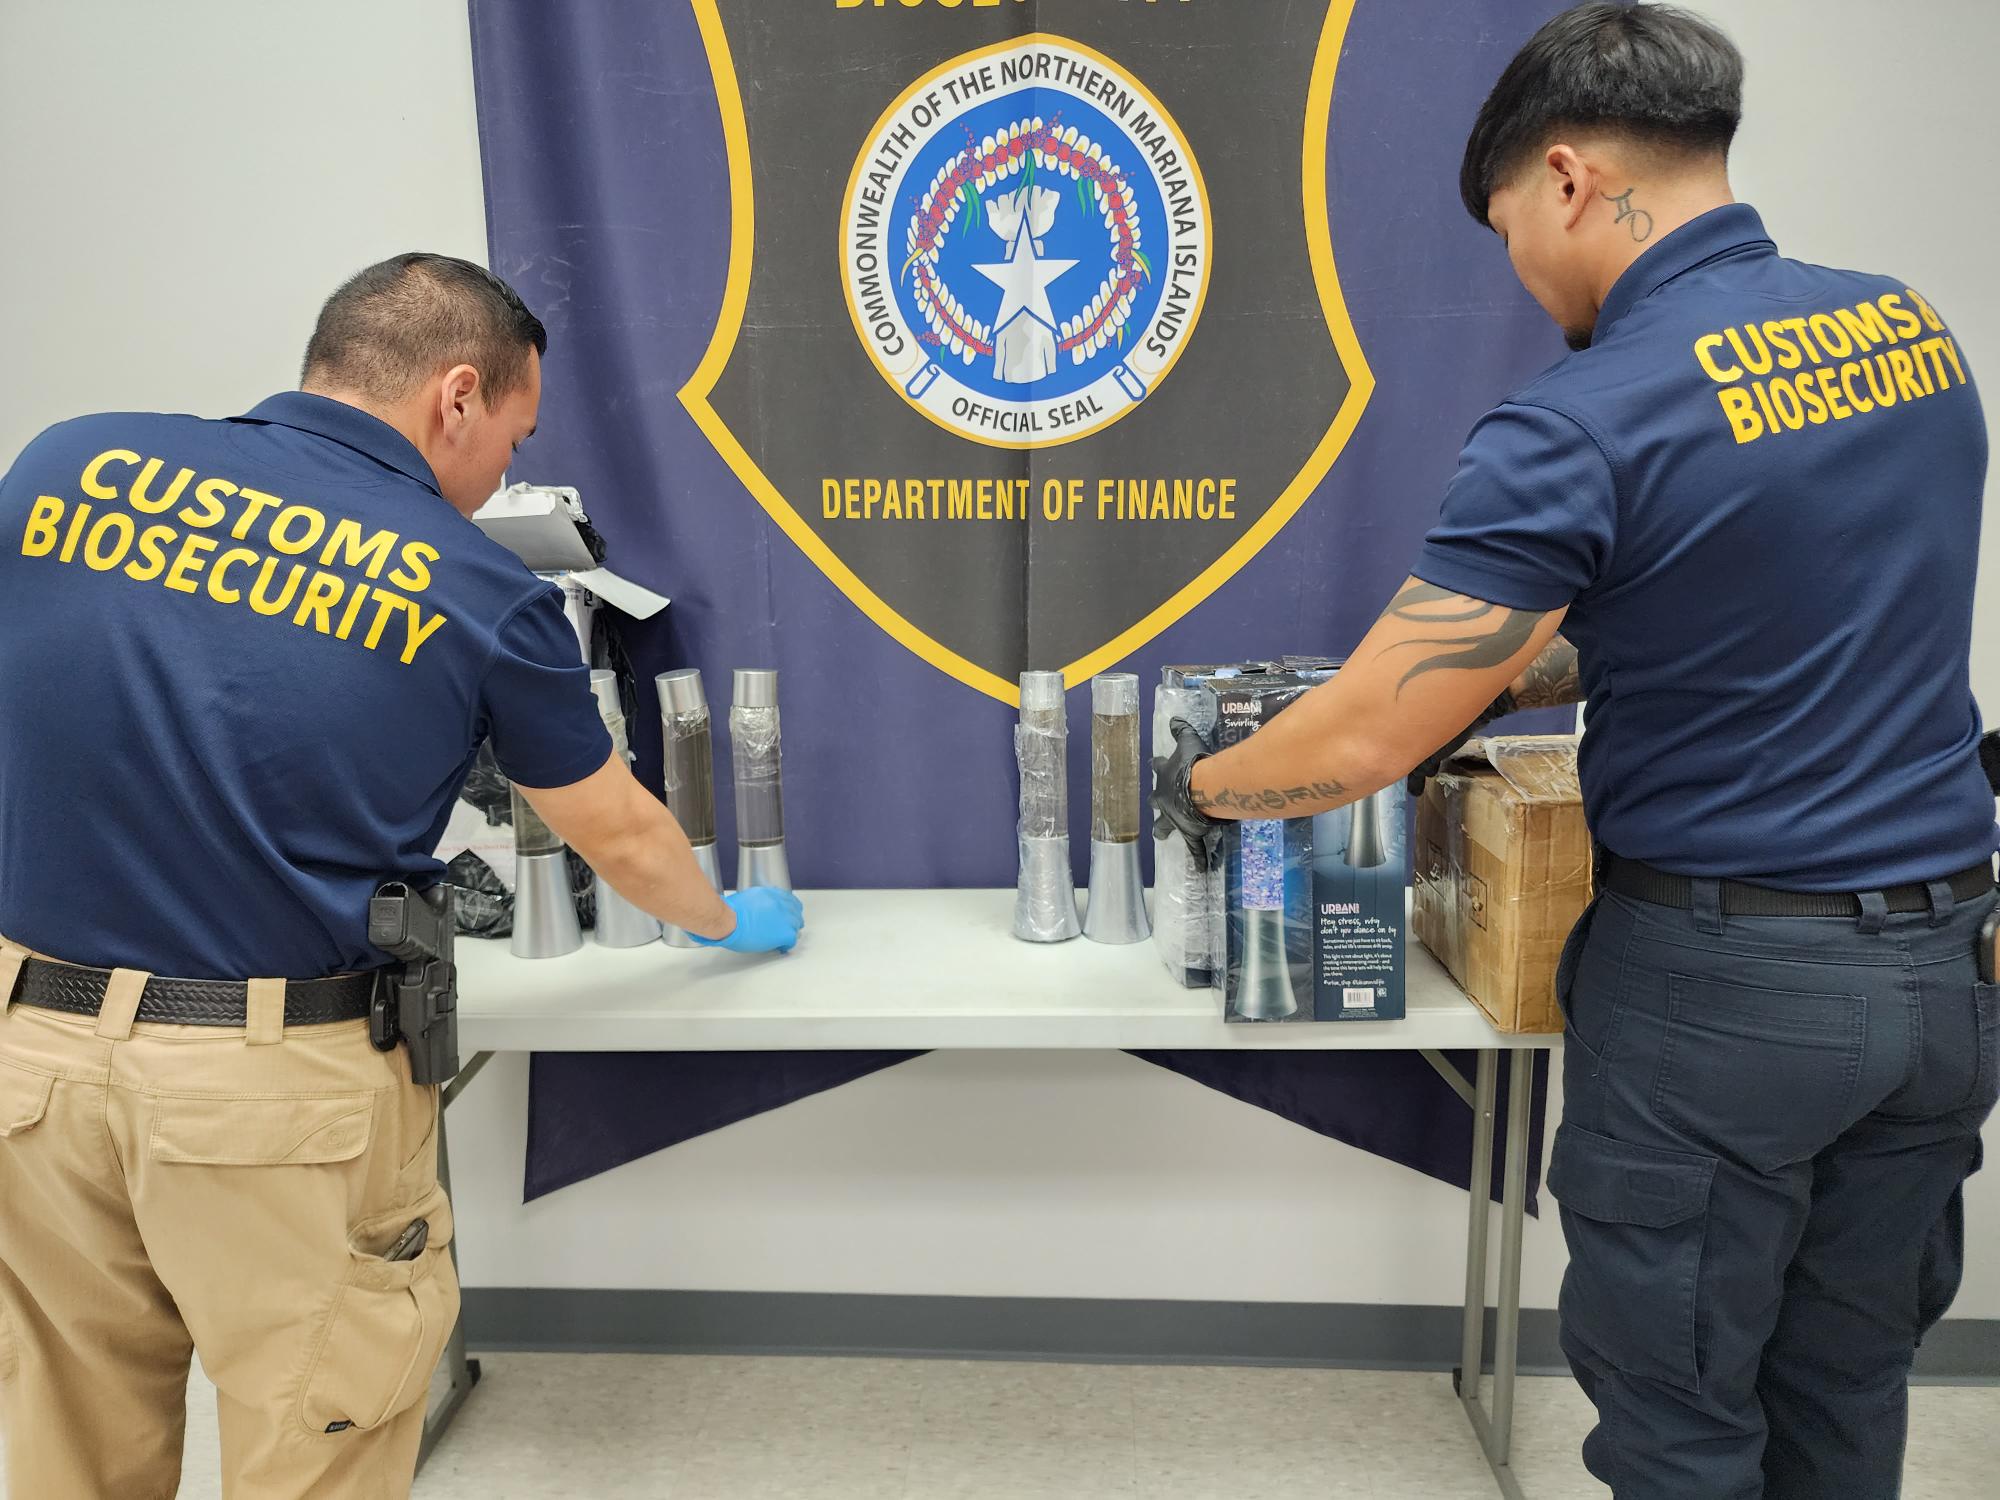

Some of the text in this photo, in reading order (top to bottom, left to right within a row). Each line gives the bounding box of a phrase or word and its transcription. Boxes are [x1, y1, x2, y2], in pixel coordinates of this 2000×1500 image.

[857, 52, 1197, 358] COMMONWEALTH OF THE NORTHERN MARIANA ISLANDS
[1694, 294, 1922, 383] CUSTOMS
[951, 395, 1104, 432] OFFICIAL SEAL
[1717, 336, 1967, 444] BIOSECURITY
[80, 449, 441, 592] CUSTOMS
[822, 478, 1237, 521] DEPARTMENT OF FINANCE
[21, 495, 447, 665] BIOSECURITY
[1224, 718, 1261, 732] Swirling
[1320, 916, 1380, 928] Hey stress, why
[1320, 926, 1338, 934] don't
[1340, 928, 1352, 938] you
[1388, 926, 1396, 938] by
